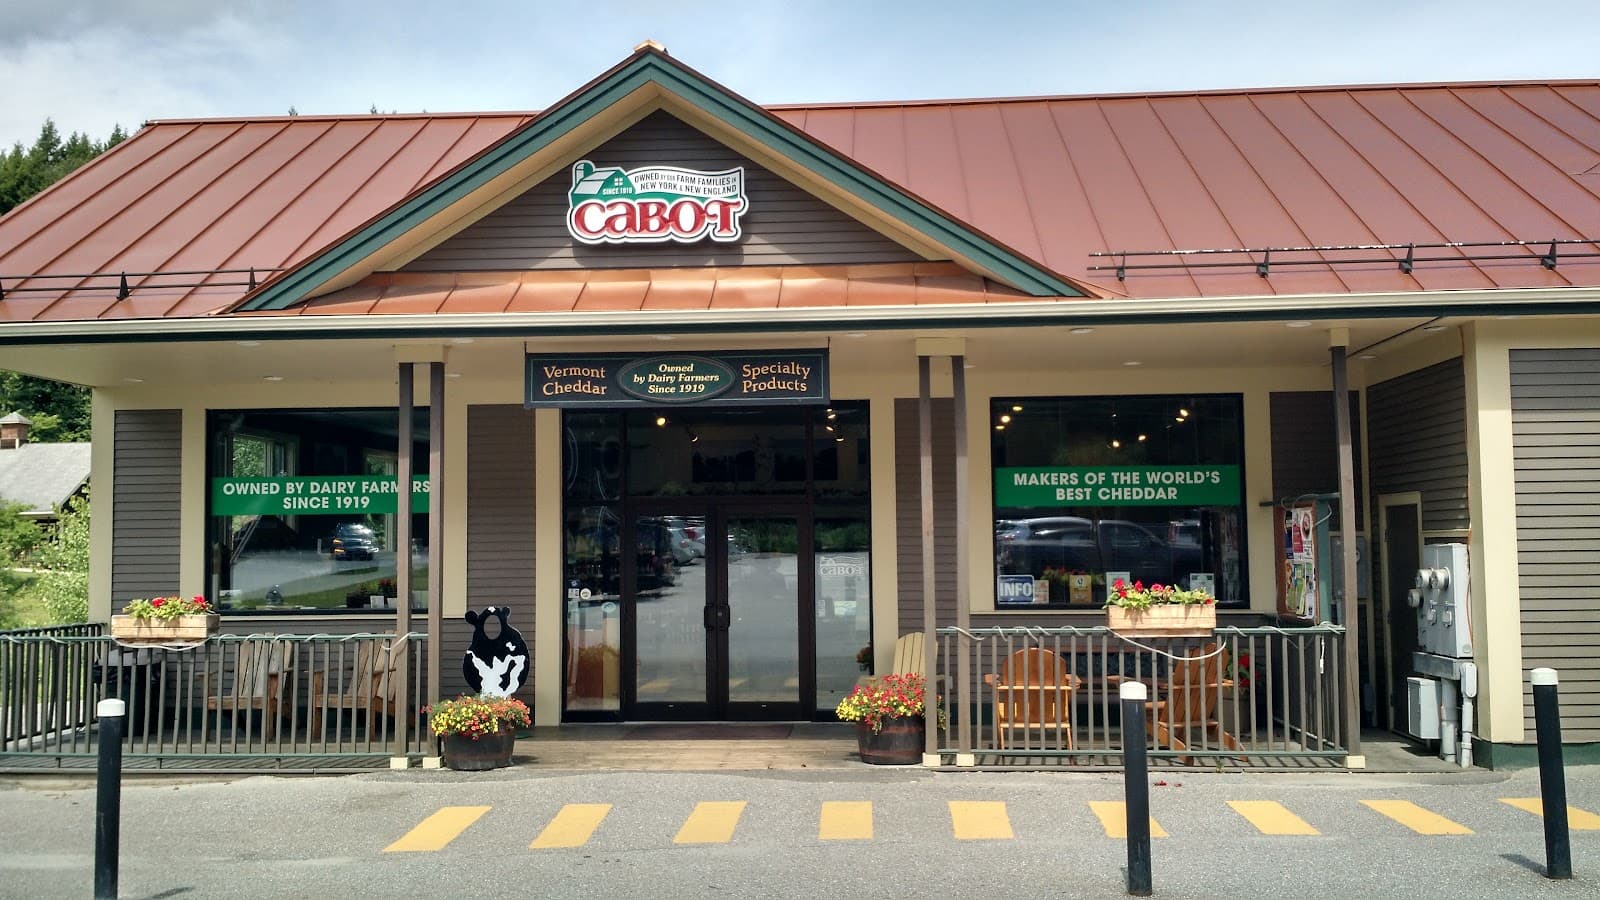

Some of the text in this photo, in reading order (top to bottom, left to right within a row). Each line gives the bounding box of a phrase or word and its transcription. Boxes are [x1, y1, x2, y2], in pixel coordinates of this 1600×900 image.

[635, 173, 660, 184] OWNED
[677, 174, 696, 184] FARM
[697, 177, 730, 186] FAMILIES
[640, 182, 657, 191] NEW
[659, 181, 678, 191] YORK
[685, 185, 701, 194] NEW
[703, 184, 737, 195] ENGLAND
[543, 366, 606, 379] Vermont
[659, 363, 694, 373] Owned
[742, 362, 811, 380] Specialty
[633, 373, 719, 385] by Dairy Farmers
[742, 377, 807, 393] Products
[542, 380, 607, 396] Cheddar
[647, 383, 705, 394] Since 1919
[1013, 471, 1221, 486] MAKERS OF THE WORLD'S
[223, 481, 430, 495] OWNED BY DAIRY FARMRS
[1056, 487, 1178, 501] BEST CHEDDAR
[282, 496, 370, 510] SINCE 1919
[999, 582, 1032, 597] INFO
